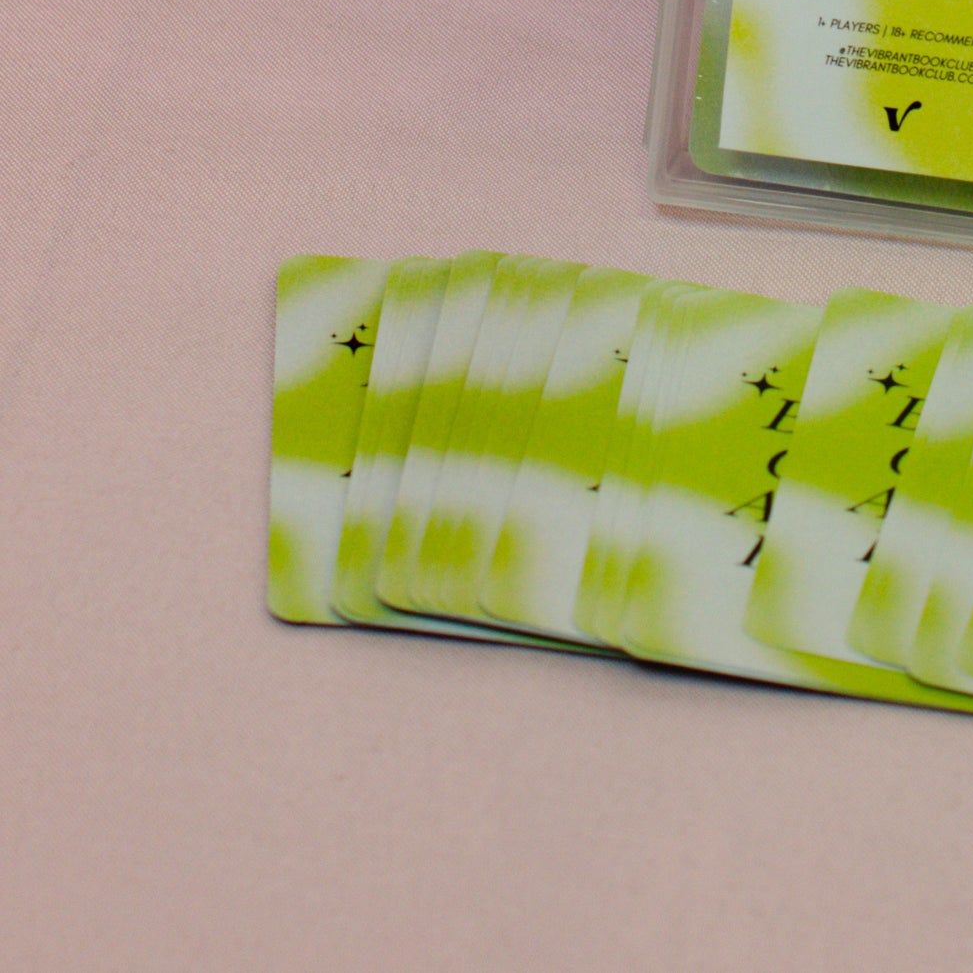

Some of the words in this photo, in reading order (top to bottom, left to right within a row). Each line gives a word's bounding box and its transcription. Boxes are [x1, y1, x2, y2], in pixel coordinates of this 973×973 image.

[818, 16, 826, 26] 1+
[830, 18, 880, 35] PLAYERS
[891, 26, 906, 37] 18+
